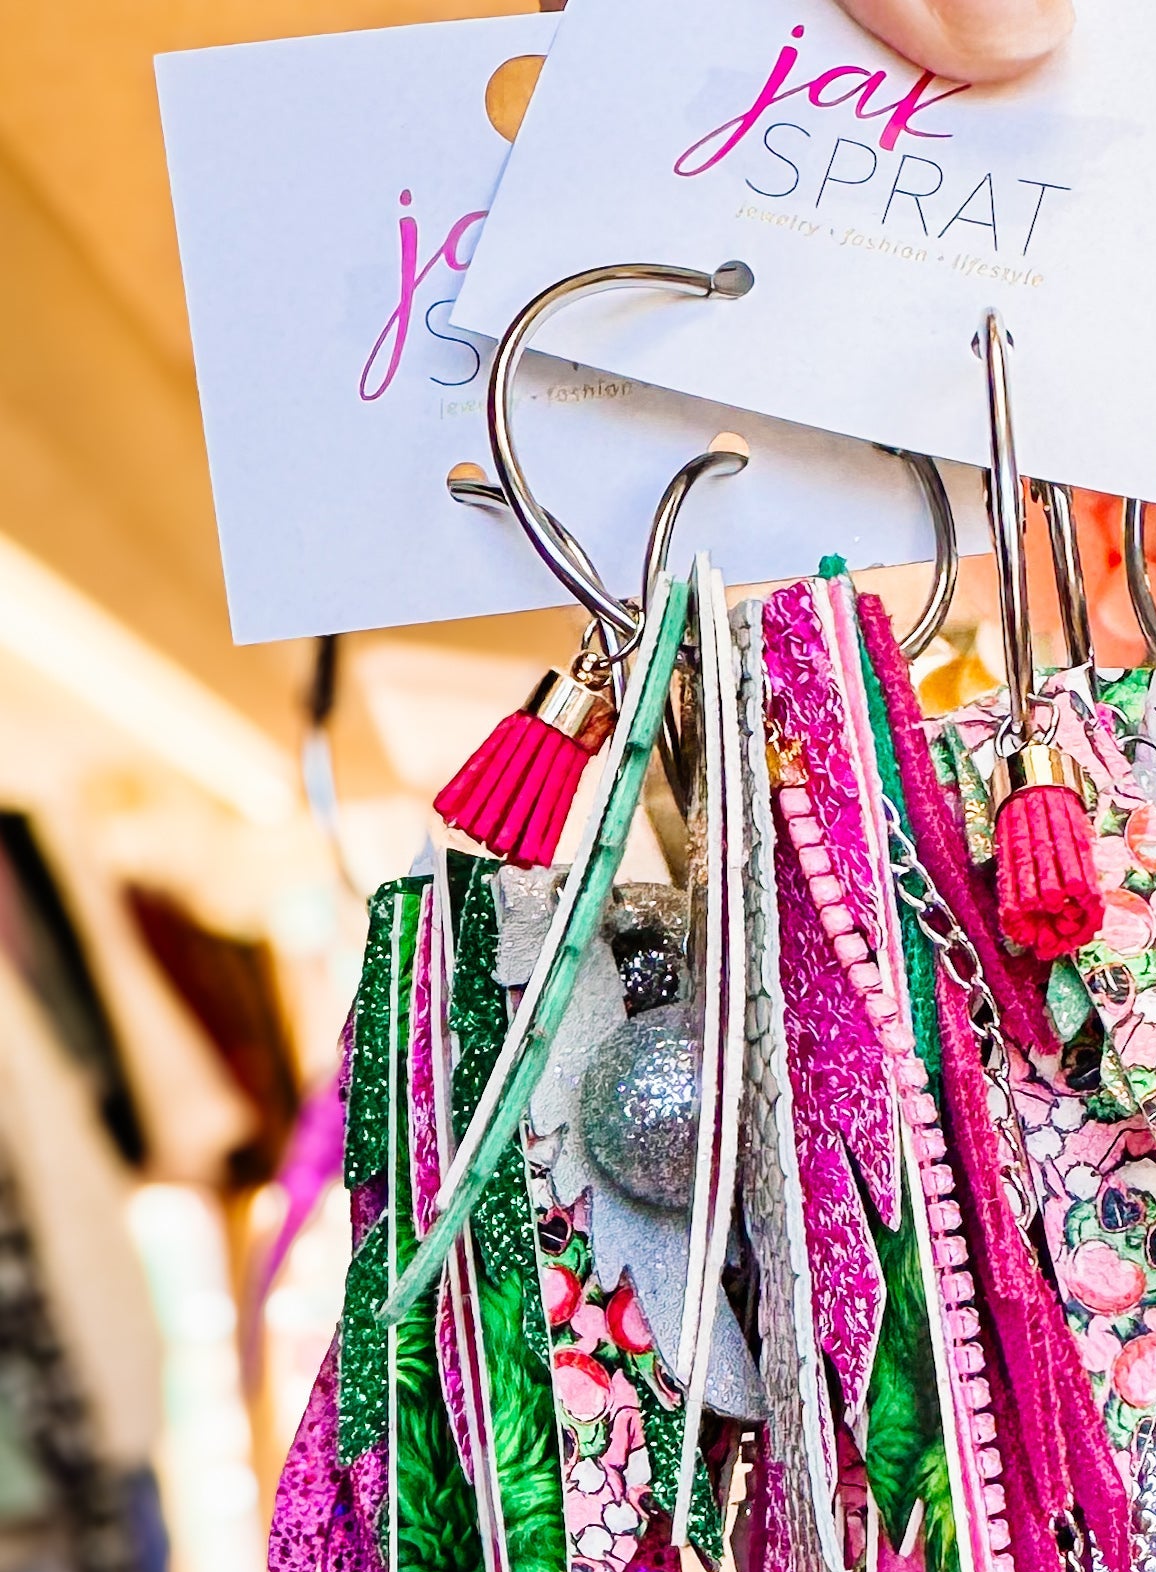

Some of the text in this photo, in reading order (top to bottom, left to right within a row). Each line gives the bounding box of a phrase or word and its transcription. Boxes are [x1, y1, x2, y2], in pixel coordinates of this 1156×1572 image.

[673, 24, 972, 177] jak
[734, 200, 1045, 289] jewelry fashion lifestyle
[745, 122, 1071, 256] SPRAT
